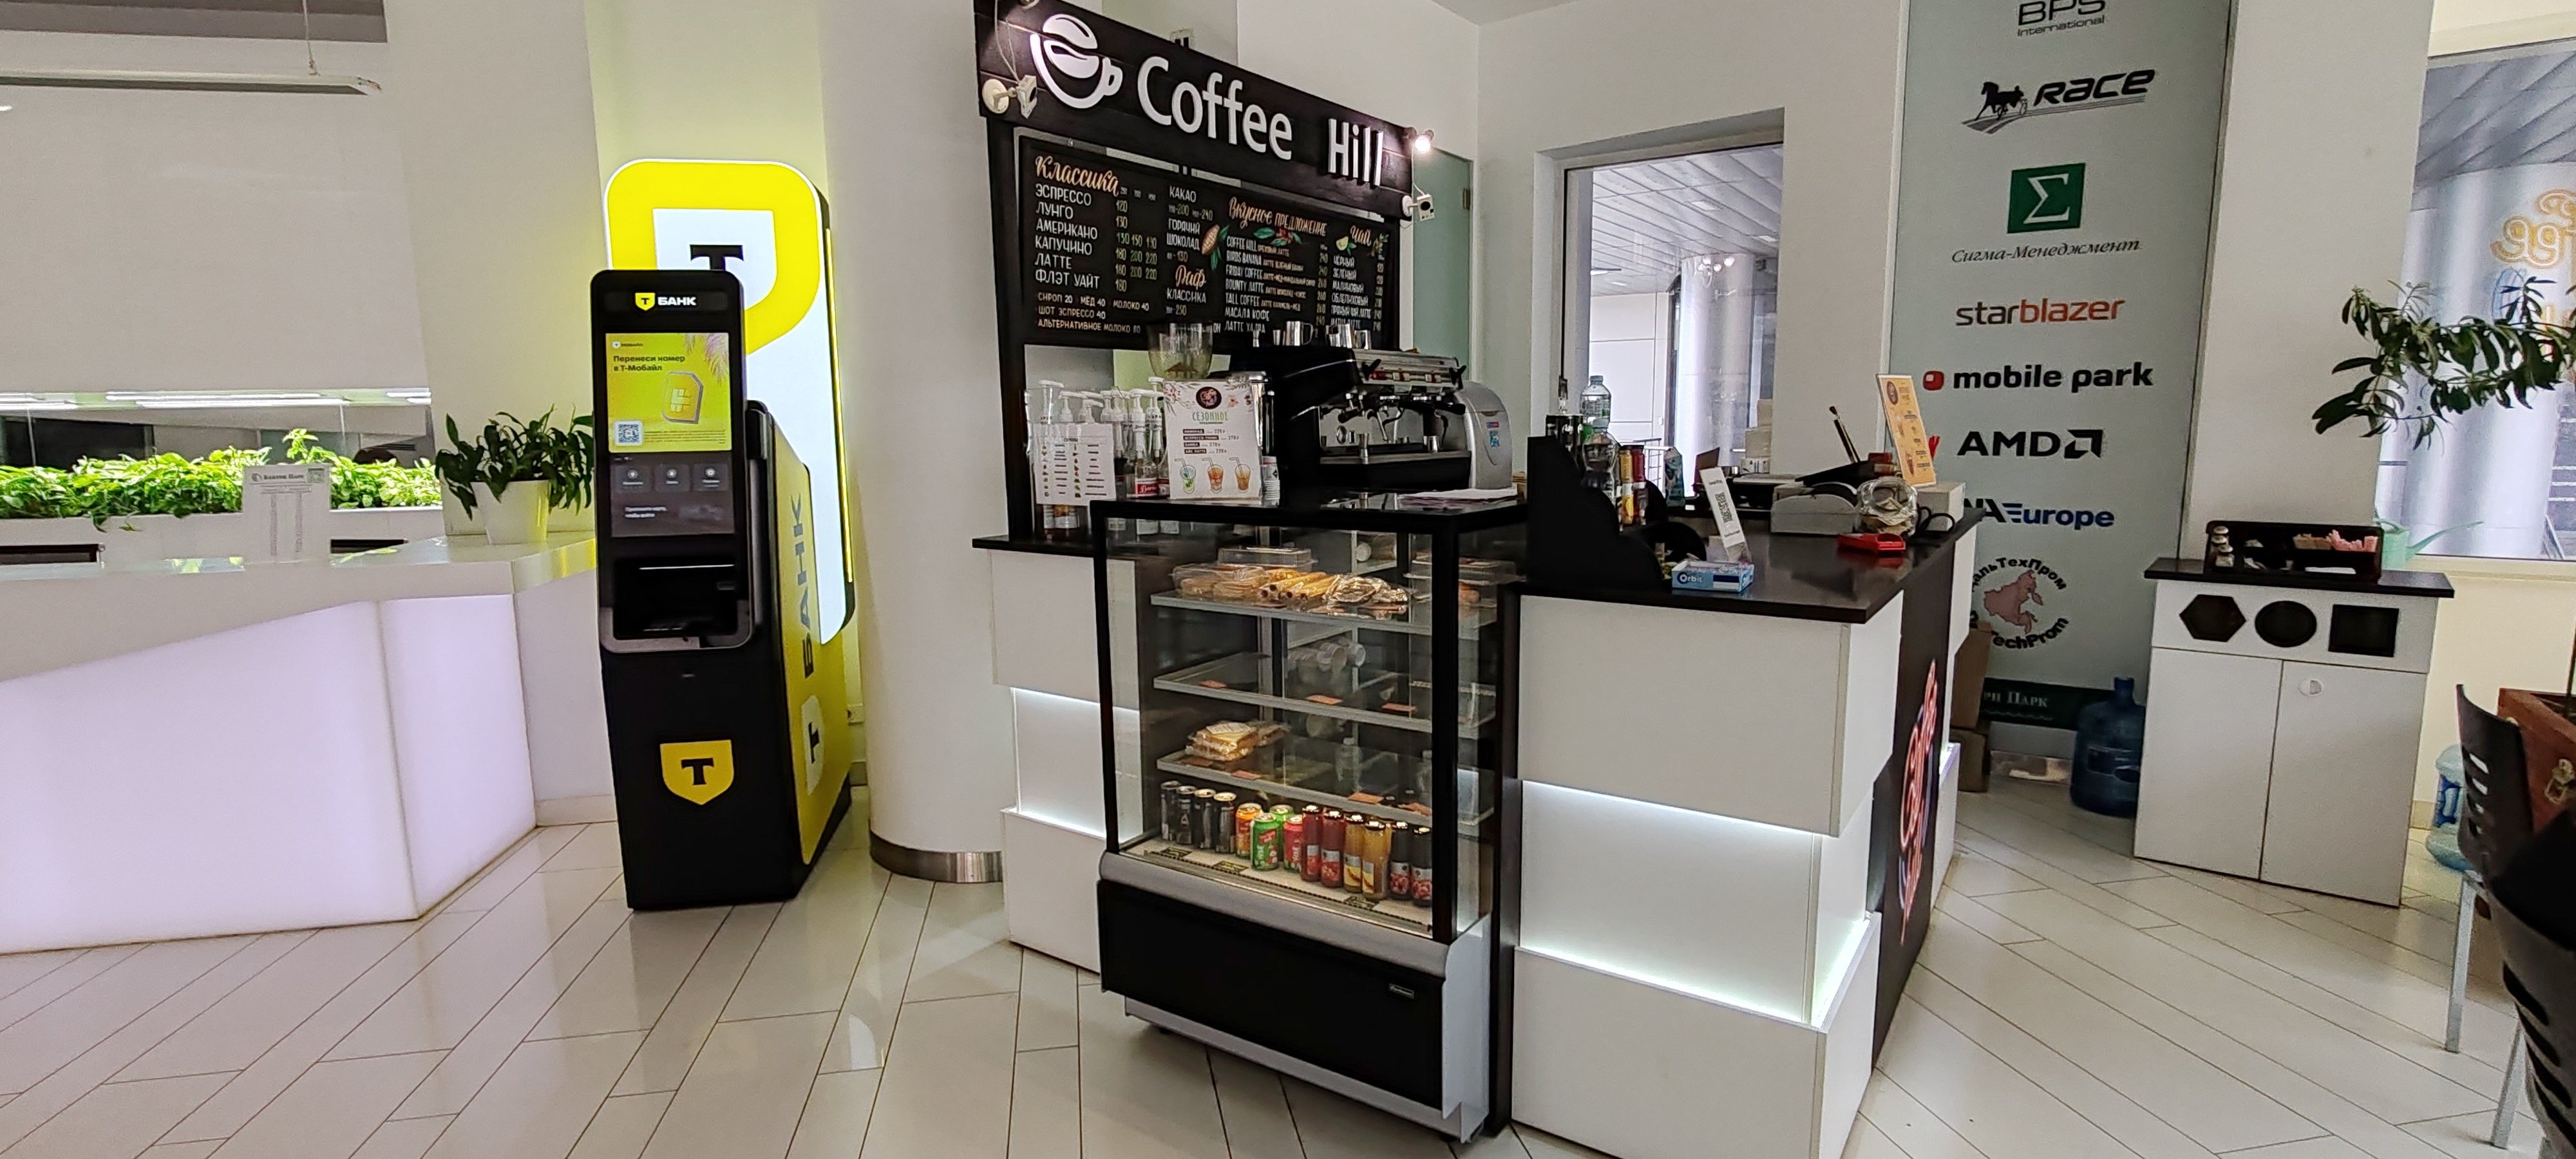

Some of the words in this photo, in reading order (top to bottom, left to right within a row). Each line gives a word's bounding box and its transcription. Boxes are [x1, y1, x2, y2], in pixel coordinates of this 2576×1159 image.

[2018, 0, 2107, 26] BPS
[2018, 14, 2105, 37] International
[1137, 55, 1292, 160] Coffee
[1328, 117, 1384, 187] Hill
[1036, 156, 1119, 197] Классика
[1035, 184, 1092, 205] ЭСПРЕССО
[1170, 185, 1197, 203] КАКАО
[1036, 201, 1074, 220] ЛУНГО
[1229, 196, 1273, 229] Вкусное
[1274, 212, 1328, 237] ПРЕДЛОЖЕНИЕ
[1036, 218, 1098, 240] АМЕРИКАНО
[1168, 218, 1201, 236] ГОРЯЧИЙ
[1350, 225, 1372, 247] Чай
[1035, 235, 1093, 256] КАПУЧИНО
[1166, 232, 1200, 251] ШОКОЛАД
[1226, 236, 1245, 251] COFFEE
[1246, 238, 1258, 252] HILL
[1951, 239, 2141, 263] Сигма-Менеджмент
[1035, 253, 1072, 270] ЛАТТЕ
[1226, 250, 1242, 264] BIRDS
[1242, 253, 1262, 266] BANANA
[1035, 269, 1070, 286] ФЛЭТ
[1074, 273, 1100, 290] УАЙТ
[1175, 265, 1207, 291] Раф
[1226, 264, 1244, 277] FRIDAY
[1244, 267, 1263, 280] COFFEE
[1166, 287, 1207, 304] КЛАССИКА
[1225, 278, 1247, 291] BOUNTY
[1248, 281, 1265, 294] ЛАТТЕ
[1332, 279, 1364, 294] МАЛИНОВЫЙ
[658, 296, 697, 306] БАНК
[1037, 292, 1063, 303] СИРОП
[1064, 294, 1073, 304] 20
[1080, 294, 1096, 308] МЁД
[1097, 297, 1106, 307] 40
[1113, 299, 1141, 310] МОЛОКО
[1141, 302, 1150, 312] 40
[1225, 292, 1239, 305] TALL
[1240, 294, 1260, 307] COFFEE
[1038, 305, 1056, 316] ШОТ
[1058, 307, 1095, 318] ЭСПРЕССО
[1096, 310, 1106, 320] 40
[1224, 306, 1251, 319] МАСАЛА
[1252, 309, 1270, 322] КОФЕ
[1956, 298, 2125, 326] starblazer
[1037, 318, 1102, 332] АЛЬТЕРНАТИВНОЕ
[1103, 323, 1131, 334] МОЛОКО
[1224, 320, 1244, 332] ЛАТТЕ
[658, 355, 685, 364] номер
[1953, 364, 2062, 389] mobile
[2071, 362, 2154, 393] park
[1192, 411, 1228, 421] СЕЗОННОЕ
[1956, 431, 2061, 457] AMD
[791, 493, 814, 679] БАНК
[1680, 573, 1703, 583] Orbit
